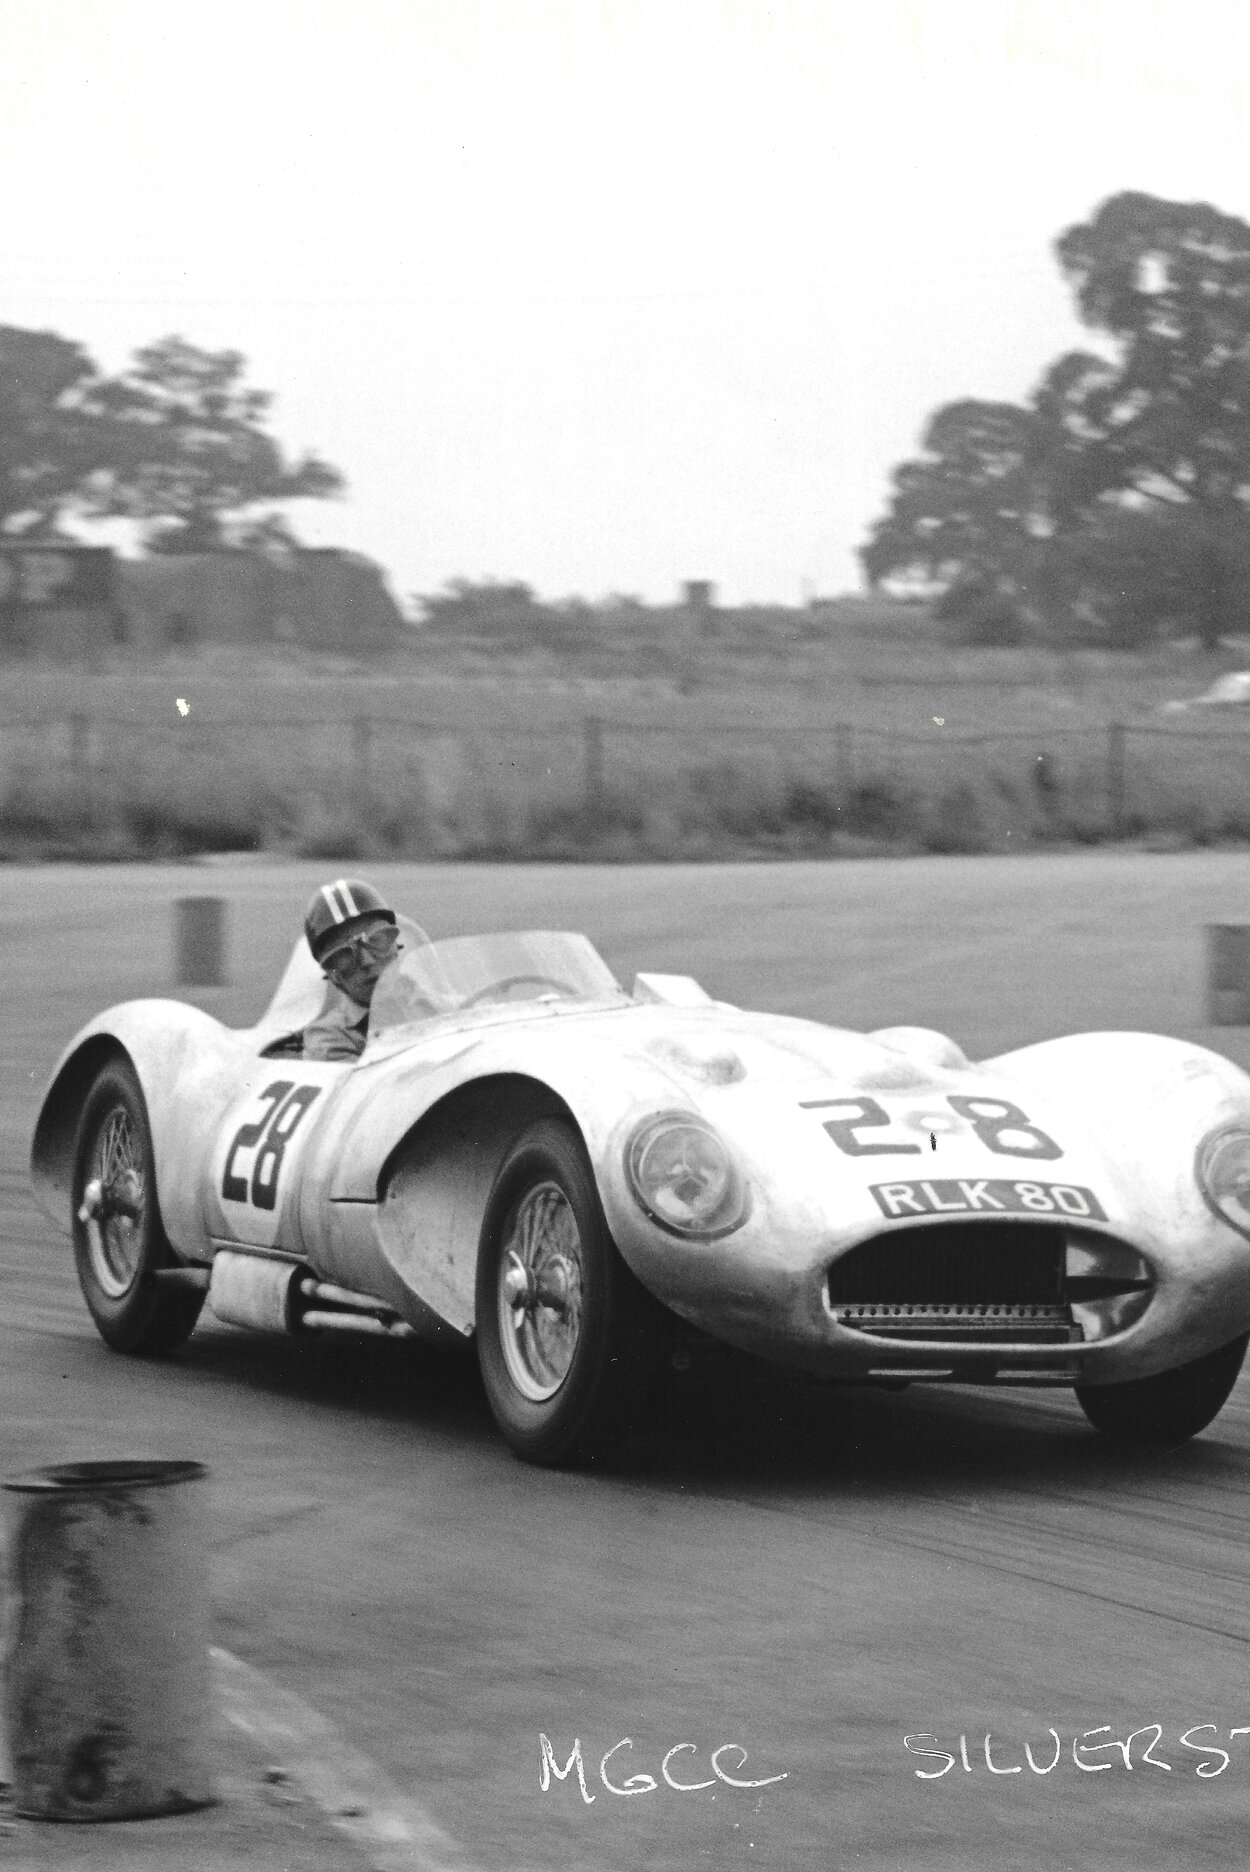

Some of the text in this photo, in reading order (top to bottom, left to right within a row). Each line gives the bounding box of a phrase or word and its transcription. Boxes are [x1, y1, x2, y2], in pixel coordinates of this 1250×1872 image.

[222, 1080, 322, 1212] 28
[878, 1181, 1091, 1217] RLK 80
